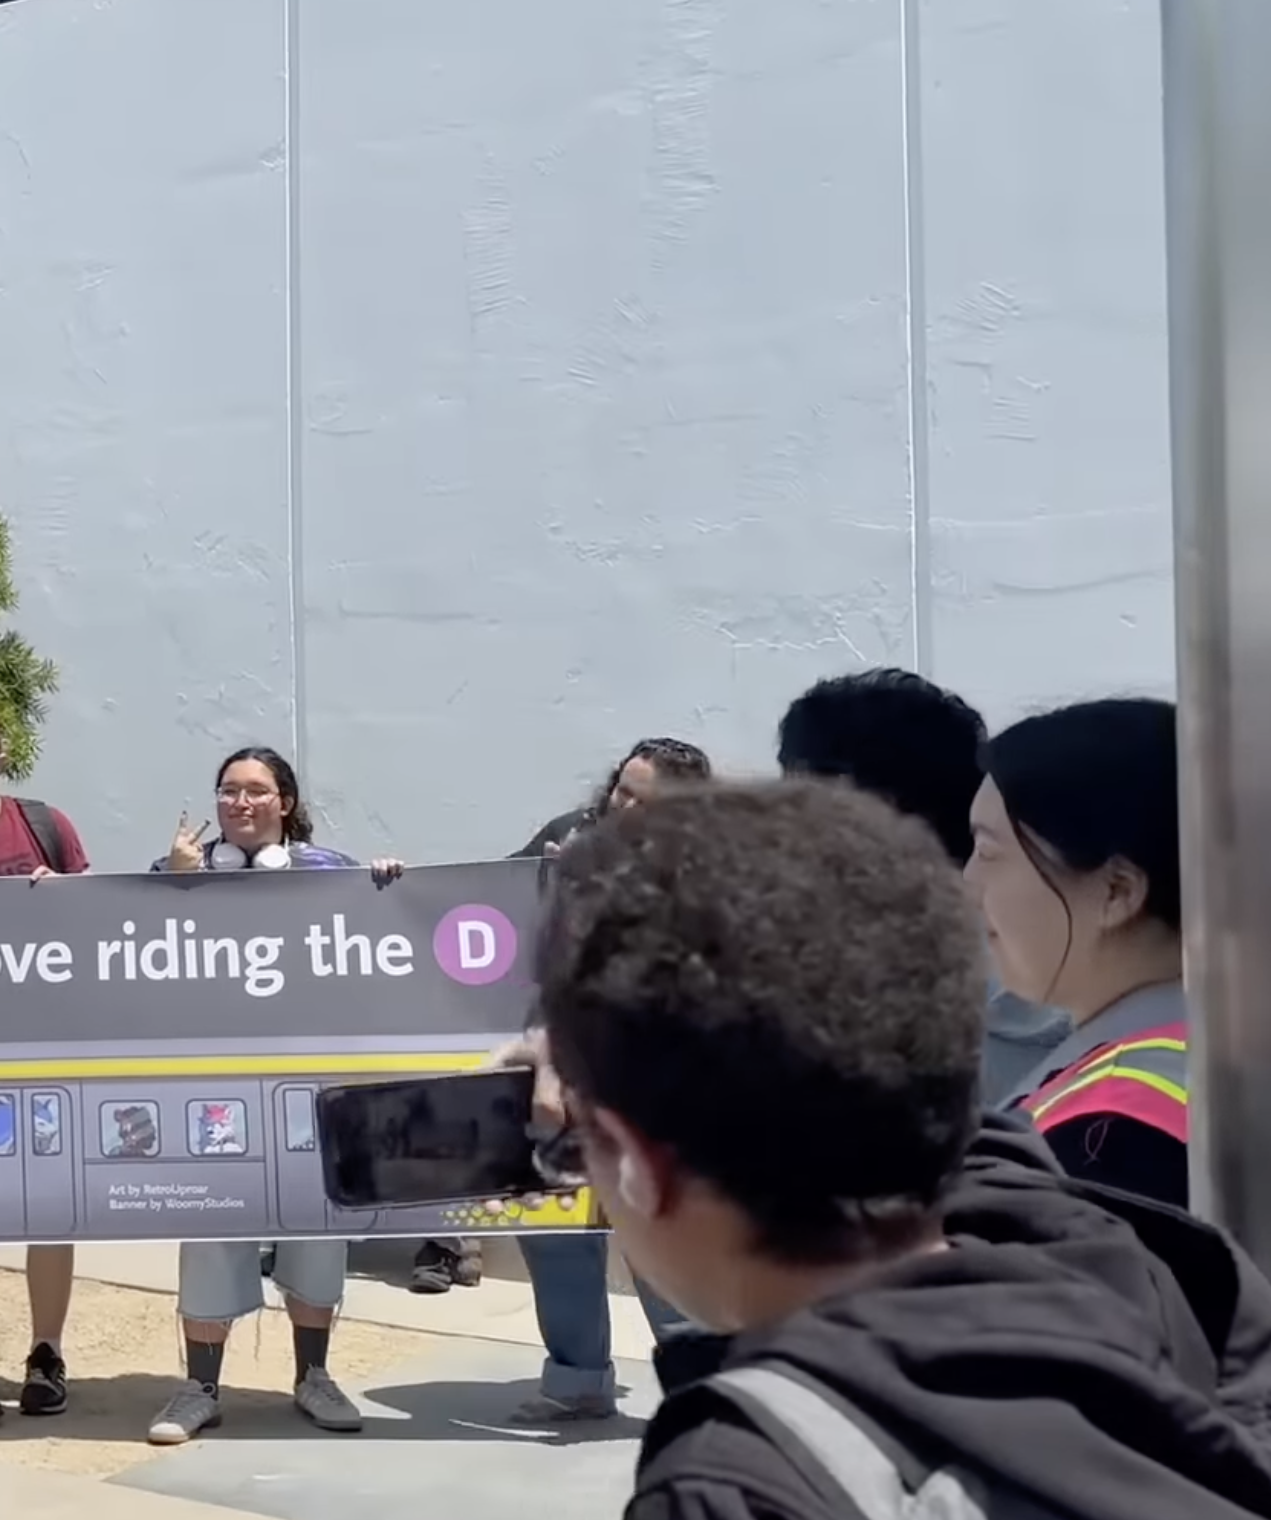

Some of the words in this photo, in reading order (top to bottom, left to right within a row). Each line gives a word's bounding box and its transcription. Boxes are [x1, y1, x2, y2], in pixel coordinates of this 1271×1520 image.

[97, 918, 284, 998] riding
[304, 913, 414, 977] the
[457, 920, 496, 969] D
[109, 1184, 126, 1196] Art
[127, 1184, 141, 1198] by
[109, 1199, 147, 1210] Banner
[149, 1197, 163, 1212] by
